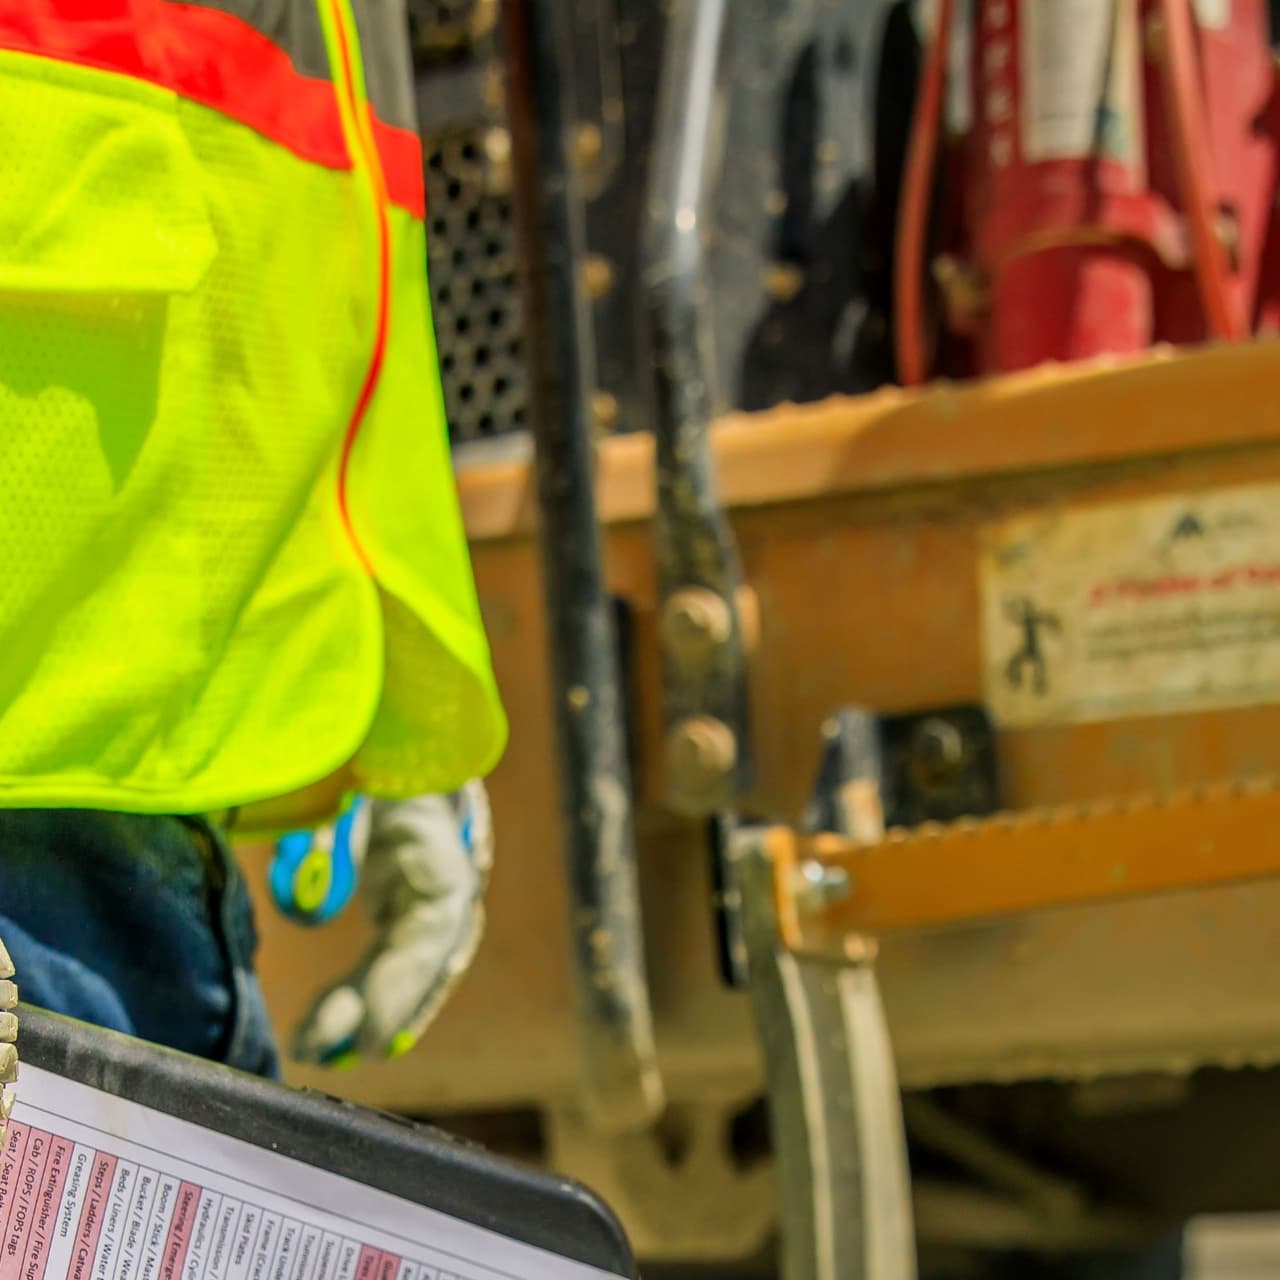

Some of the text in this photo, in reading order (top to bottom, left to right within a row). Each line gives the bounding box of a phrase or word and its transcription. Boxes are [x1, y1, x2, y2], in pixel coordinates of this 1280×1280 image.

[8, 1130, 20, 1152] Seat
[53, 1145, 64, 1164] Fire
[0, 1162, 12, 1185] Seat
[94, 1160, 107, 1188] Steps
[117, 1168, 129, 1193] Beds
[8, 1136, 43, 1256] Cab ROPS FOPS tags
[38, 1166, 59, 1230] Extinguisher
[60, 1152, 86, 1237] Greasing System
[136, 1176, 150, 1214] Bucket
[84, 1198, 99, 1238] Ladders
[108, 1202, 121, 1233] Liners
[175, 1190, 191, 1232] Steering
[194, 1197, 213, 1249] Hydraulics
[127, 1220, 139, 1248] Blade
[143, 1184, 171, 1280] Boom Stick Mast
[213, 1205, 233, 1271] Transmission
[236, 1213, 253, 1265] Skid Plates
[260, 1219, 273, 1250] Frame
[282, 1227, 294, 1253] Track
[31, 1240, 42, 1259] Fire
[98, 1243, 111, 1275] Water
